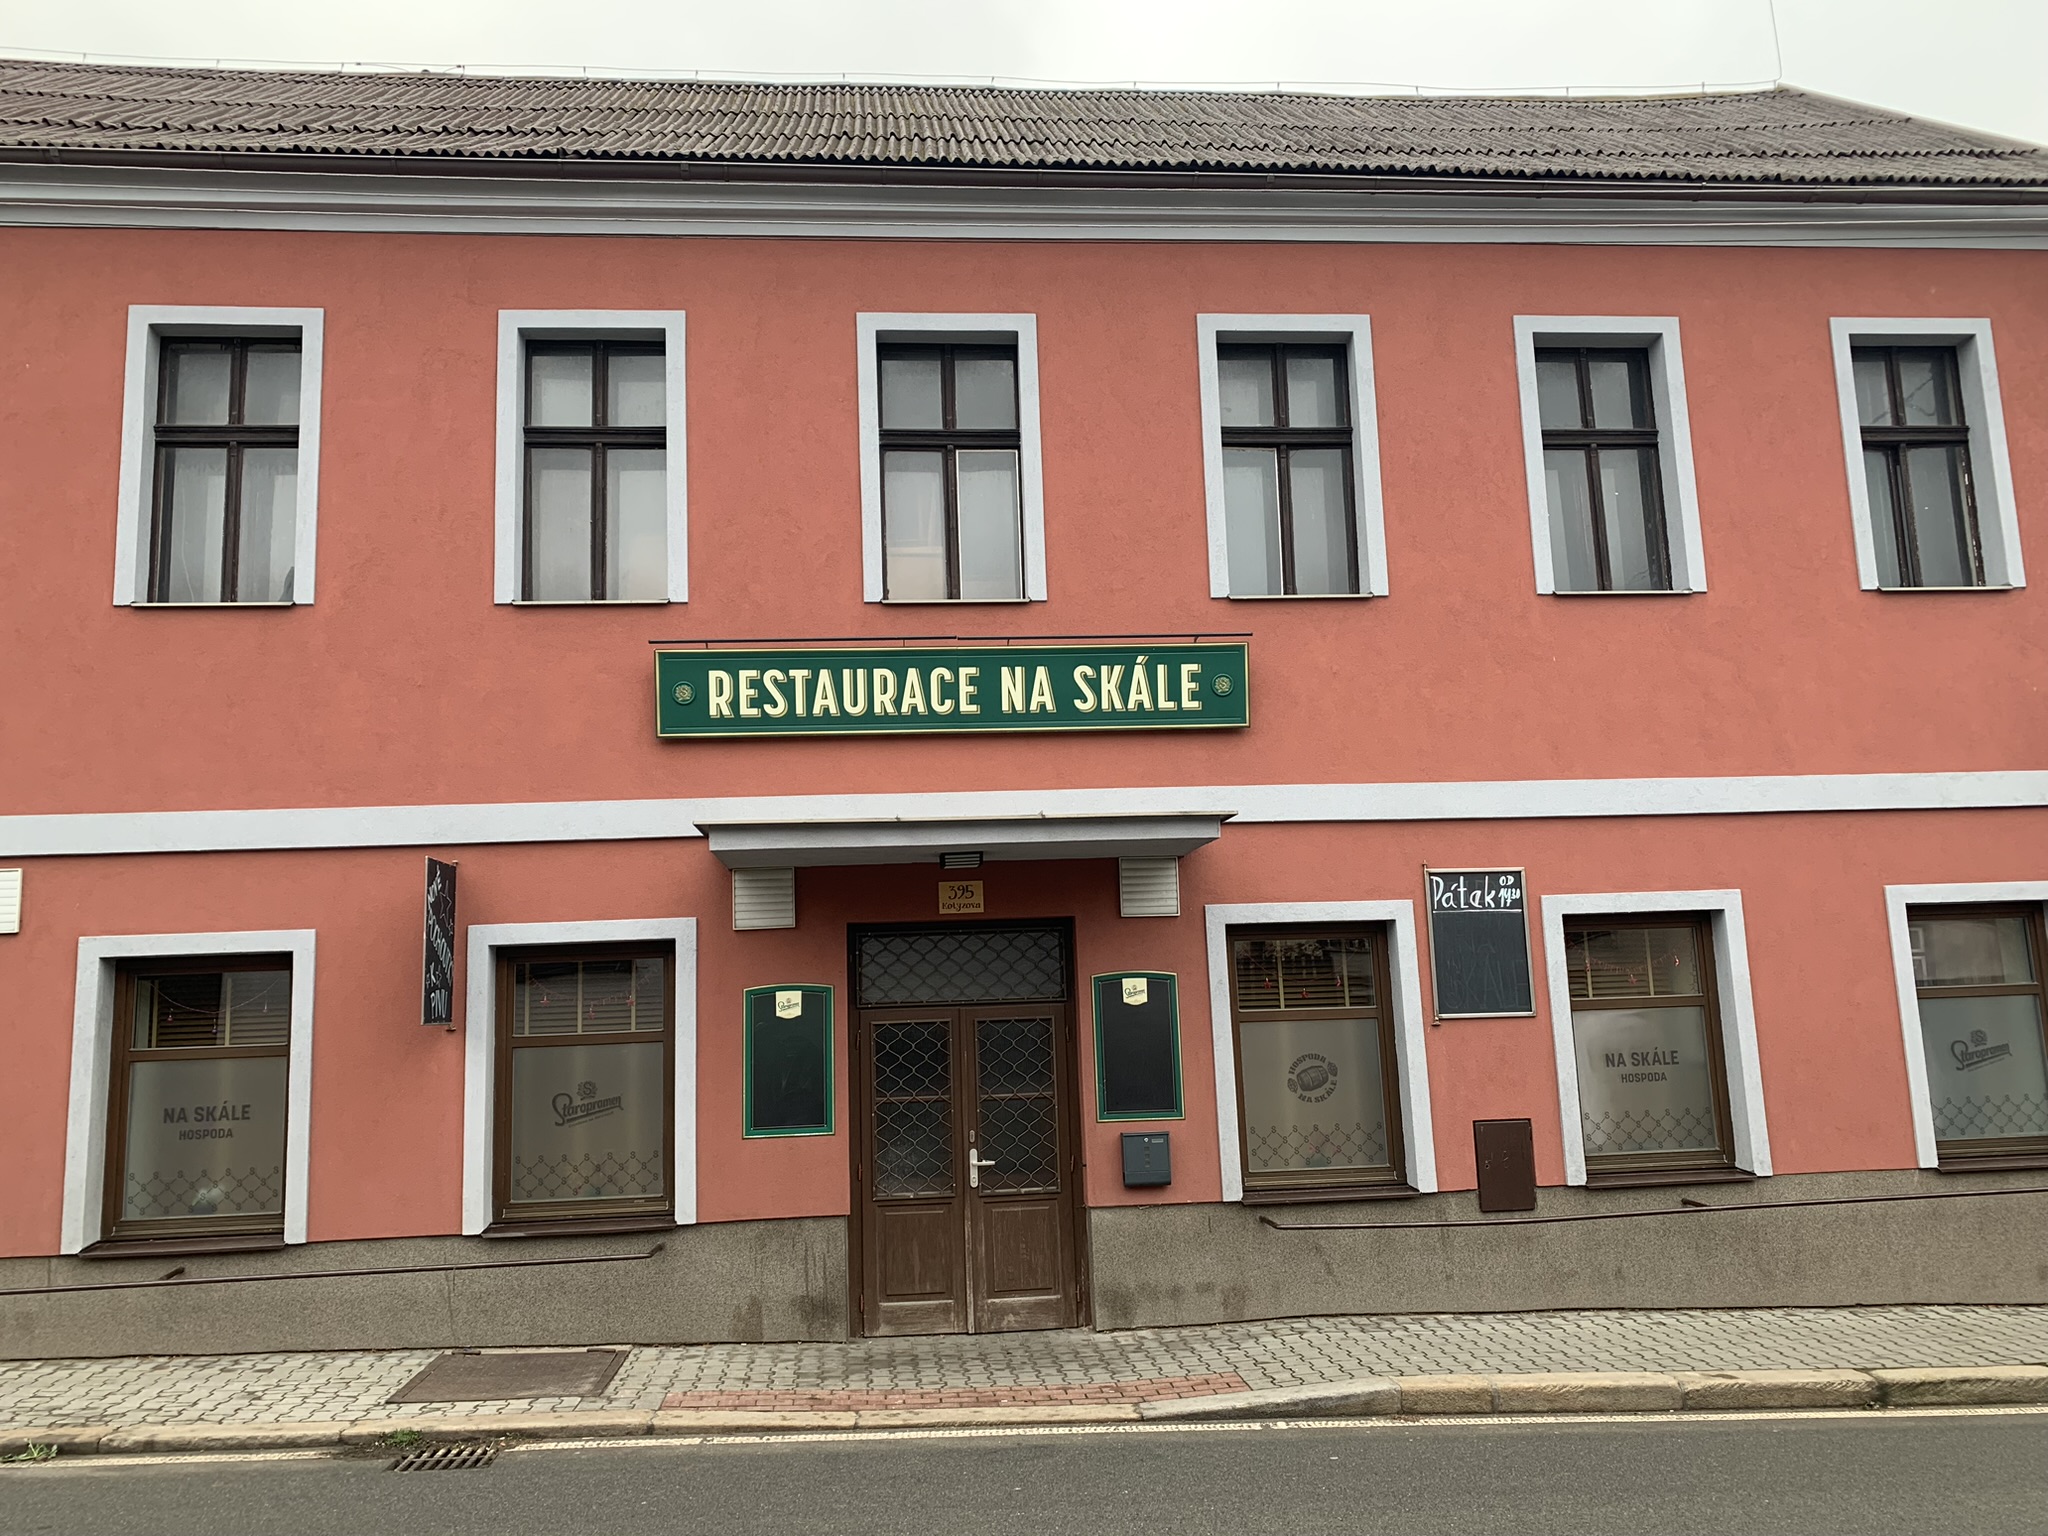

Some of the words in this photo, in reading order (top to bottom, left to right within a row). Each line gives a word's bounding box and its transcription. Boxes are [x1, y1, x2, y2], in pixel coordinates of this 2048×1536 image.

[707, 667, 980, 718] RESTAURACE
[1000, 665, 1057, 713] NA
[1073, 655, 1202, 713] SKÁLE
[948, 884, 975, 900] 395
[429, 961, 437, 988] K
[1288, 1053, 1326, 1075] HOSPODA
[1605, 1052, 1627, 1068] NA
[1631, 1046, 1679, 1067] SKÁLE
[1621, 1071, 1668, 1083] HOSPODA
[164, 1107, 188, 1124] NA
[194, 1100, 251, 1122] SKÁLE
[552, 1092, 624, 1127] Staropramen
[179, 1128, 234, 1141] HOSPODA
